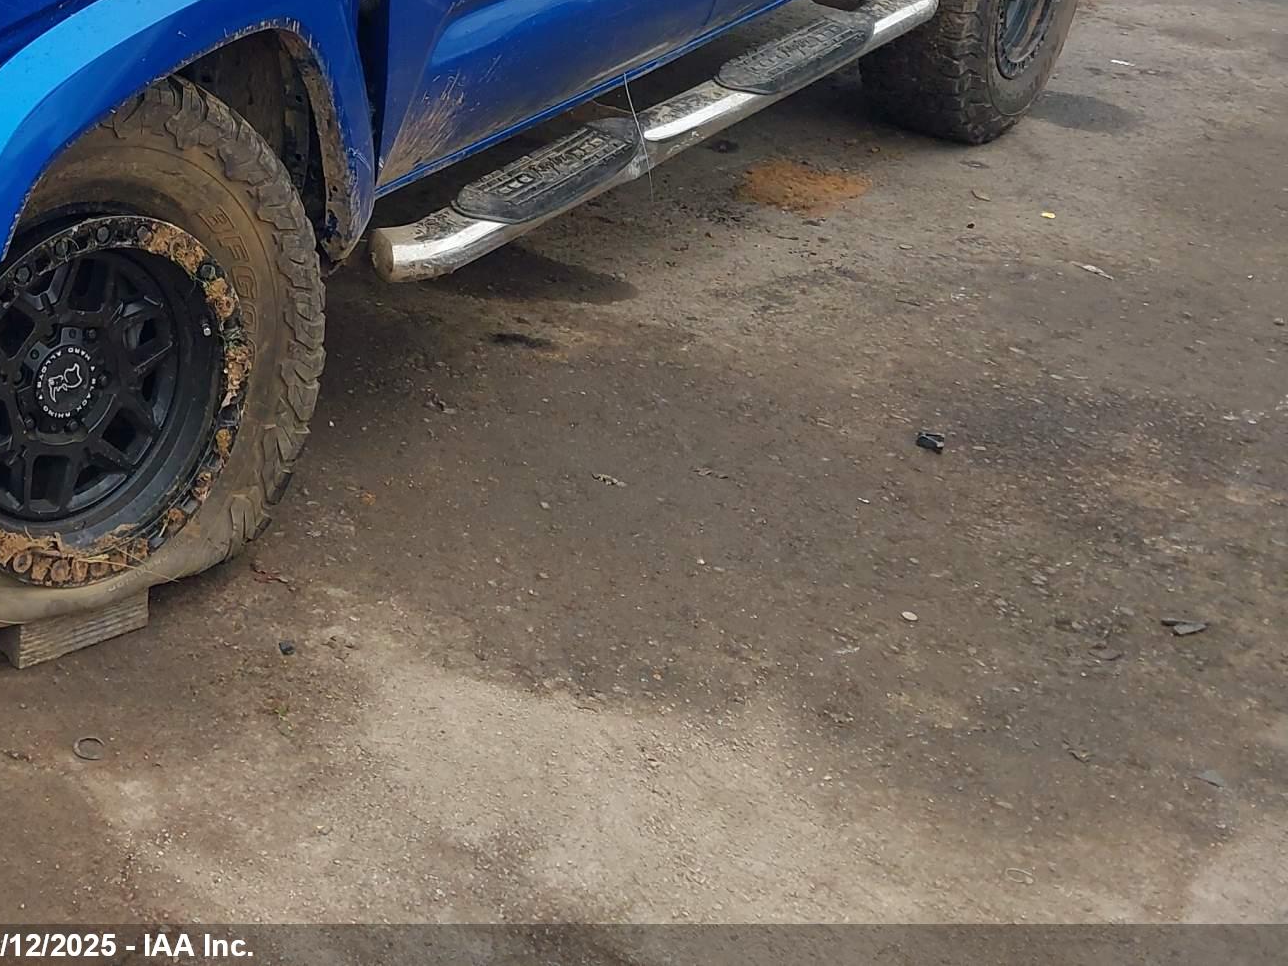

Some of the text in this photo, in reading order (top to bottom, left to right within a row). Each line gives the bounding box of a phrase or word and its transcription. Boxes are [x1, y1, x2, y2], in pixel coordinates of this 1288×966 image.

[36, 347, 91, 389] HARD ALLOYS
[42, 377, 97, 419] BLACK RHINO
